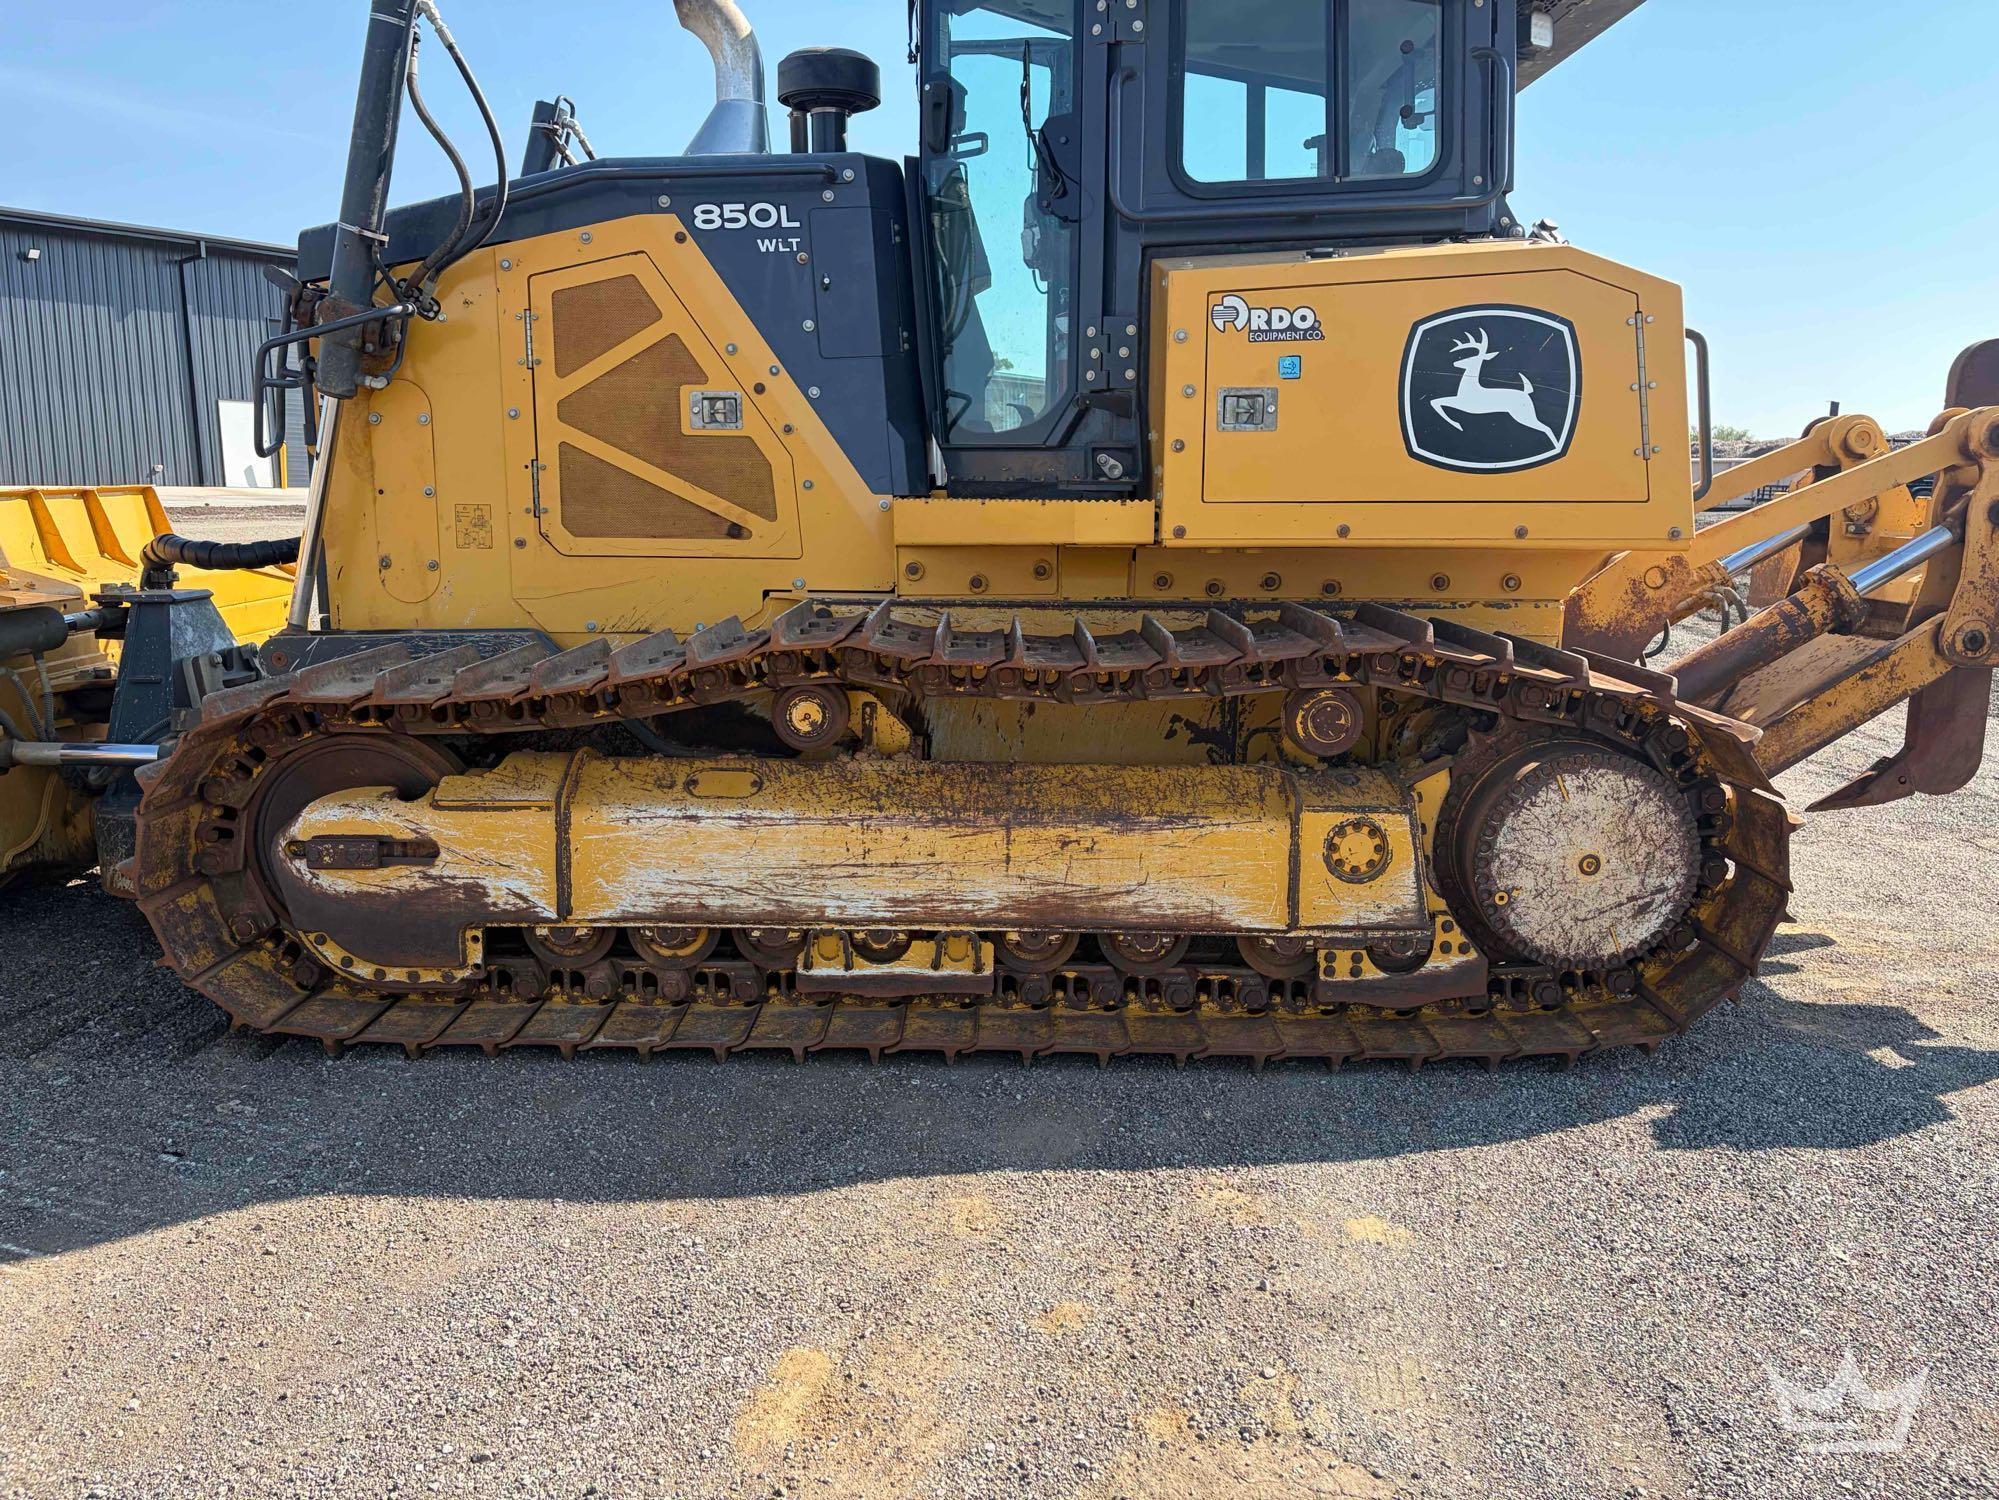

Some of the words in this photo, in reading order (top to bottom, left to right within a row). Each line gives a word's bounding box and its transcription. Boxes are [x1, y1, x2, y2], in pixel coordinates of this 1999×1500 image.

[693, 203, 801, 230] 850L
[757, 238, 801, 253] WLT
[1249, 331, 1304, 341] EQUIPMENT
[1306, 330, 1324, 340] CO.
